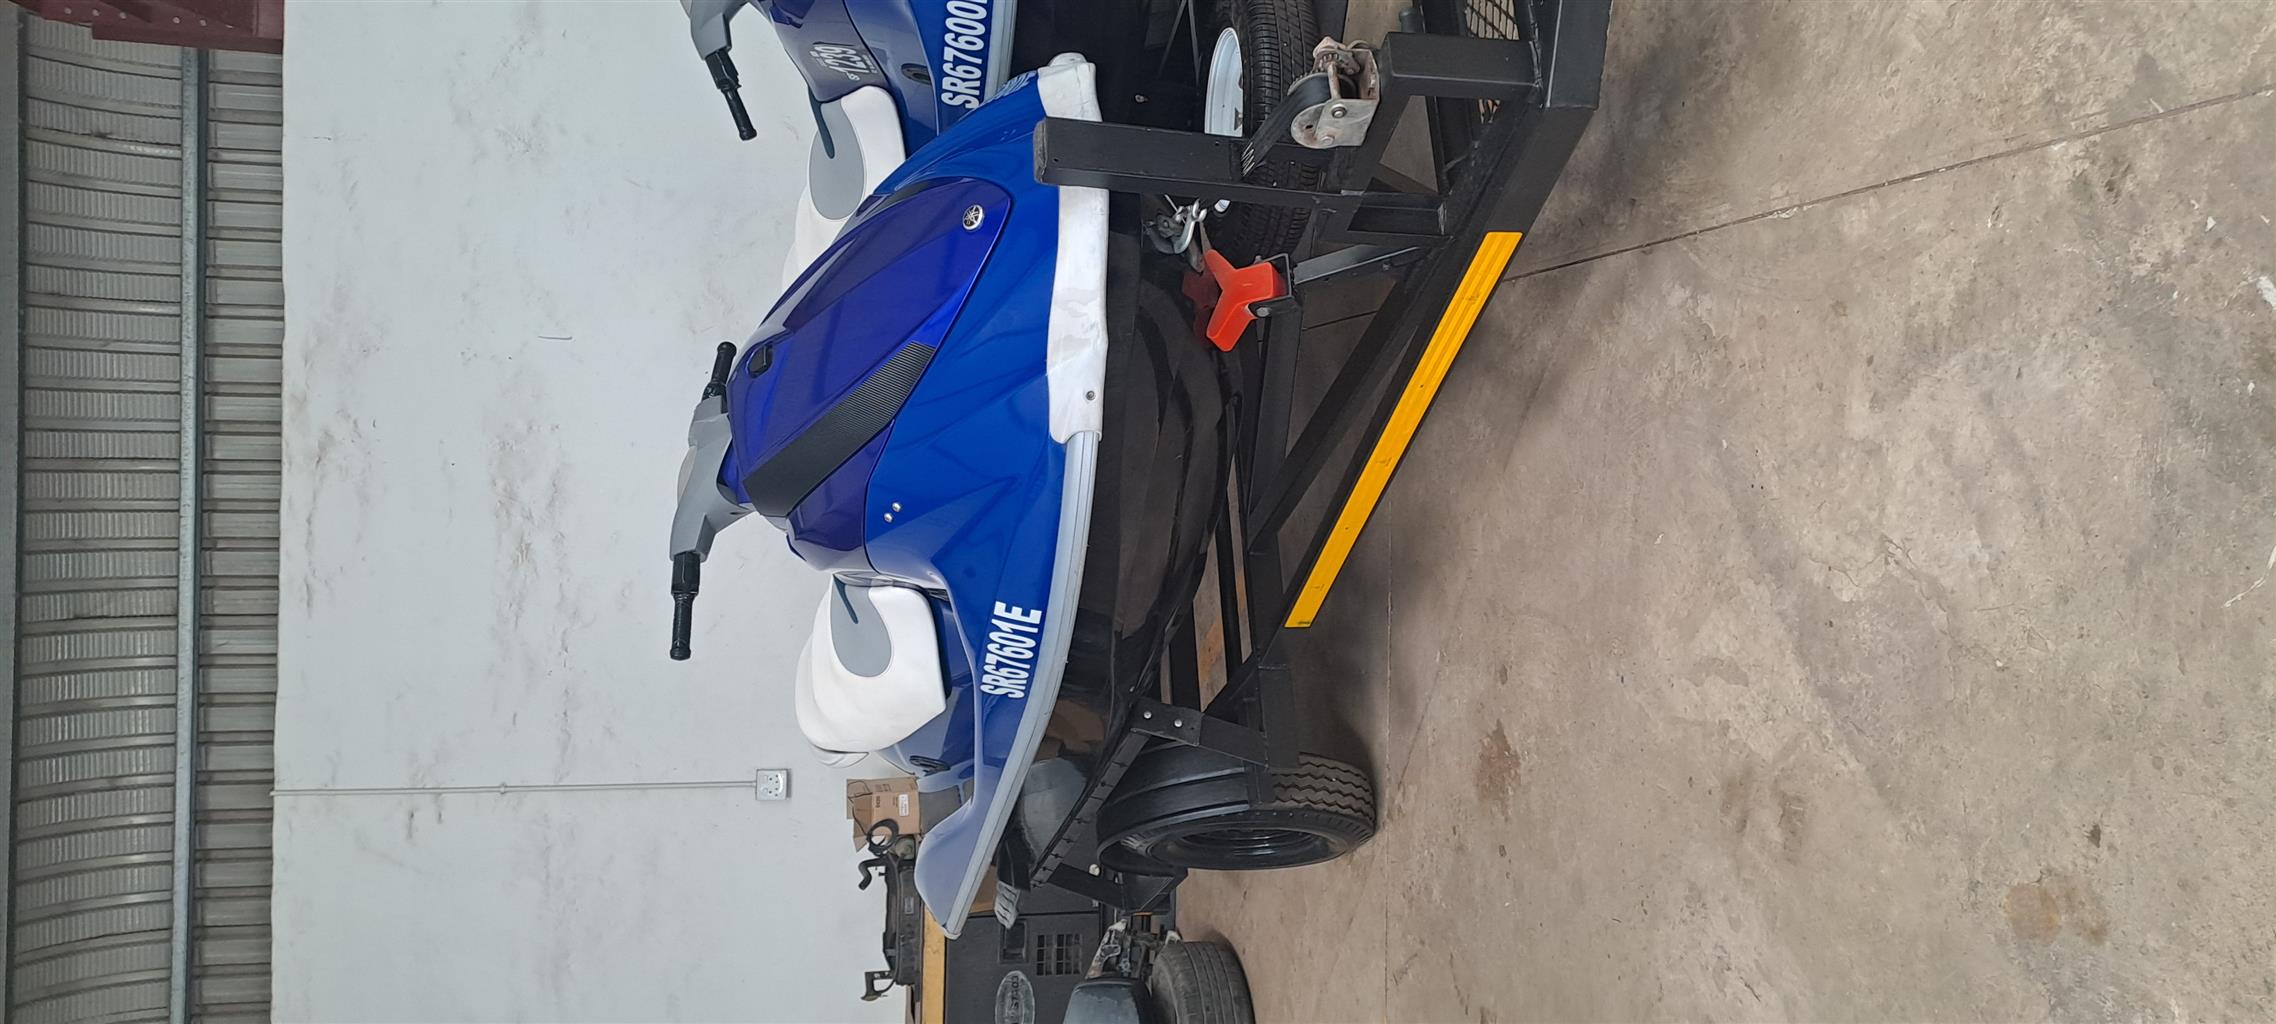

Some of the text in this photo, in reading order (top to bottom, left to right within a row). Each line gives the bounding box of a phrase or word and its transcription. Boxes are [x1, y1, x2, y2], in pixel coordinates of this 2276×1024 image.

[814, 47, 870, 73] 1239
[940, 0, 988, 109] SR67600
[980, 601, 1042, 699] SR67601E
